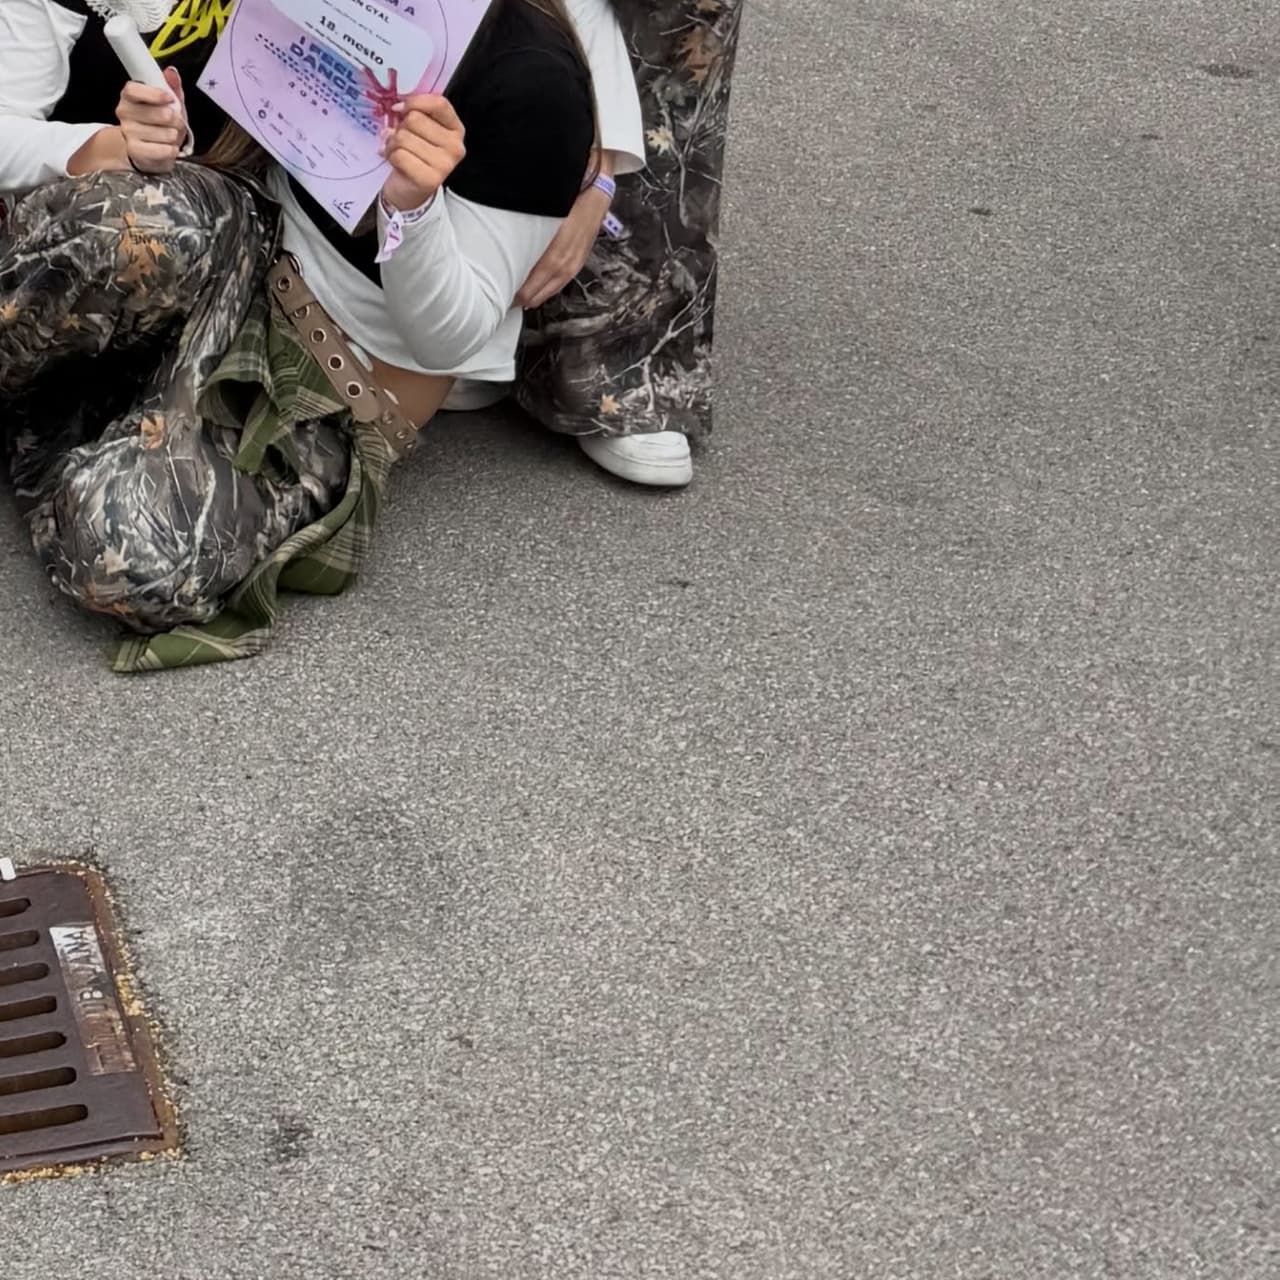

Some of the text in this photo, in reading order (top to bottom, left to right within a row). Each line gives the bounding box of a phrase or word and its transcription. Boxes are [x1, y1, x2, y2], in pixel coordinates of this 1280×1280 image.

[309, 41, 358, 84] FEEL
[319, 15, 339, 36] 18.
[342, 32, 385, 66] mesto
[290, 42, 363, 101] DANCE
